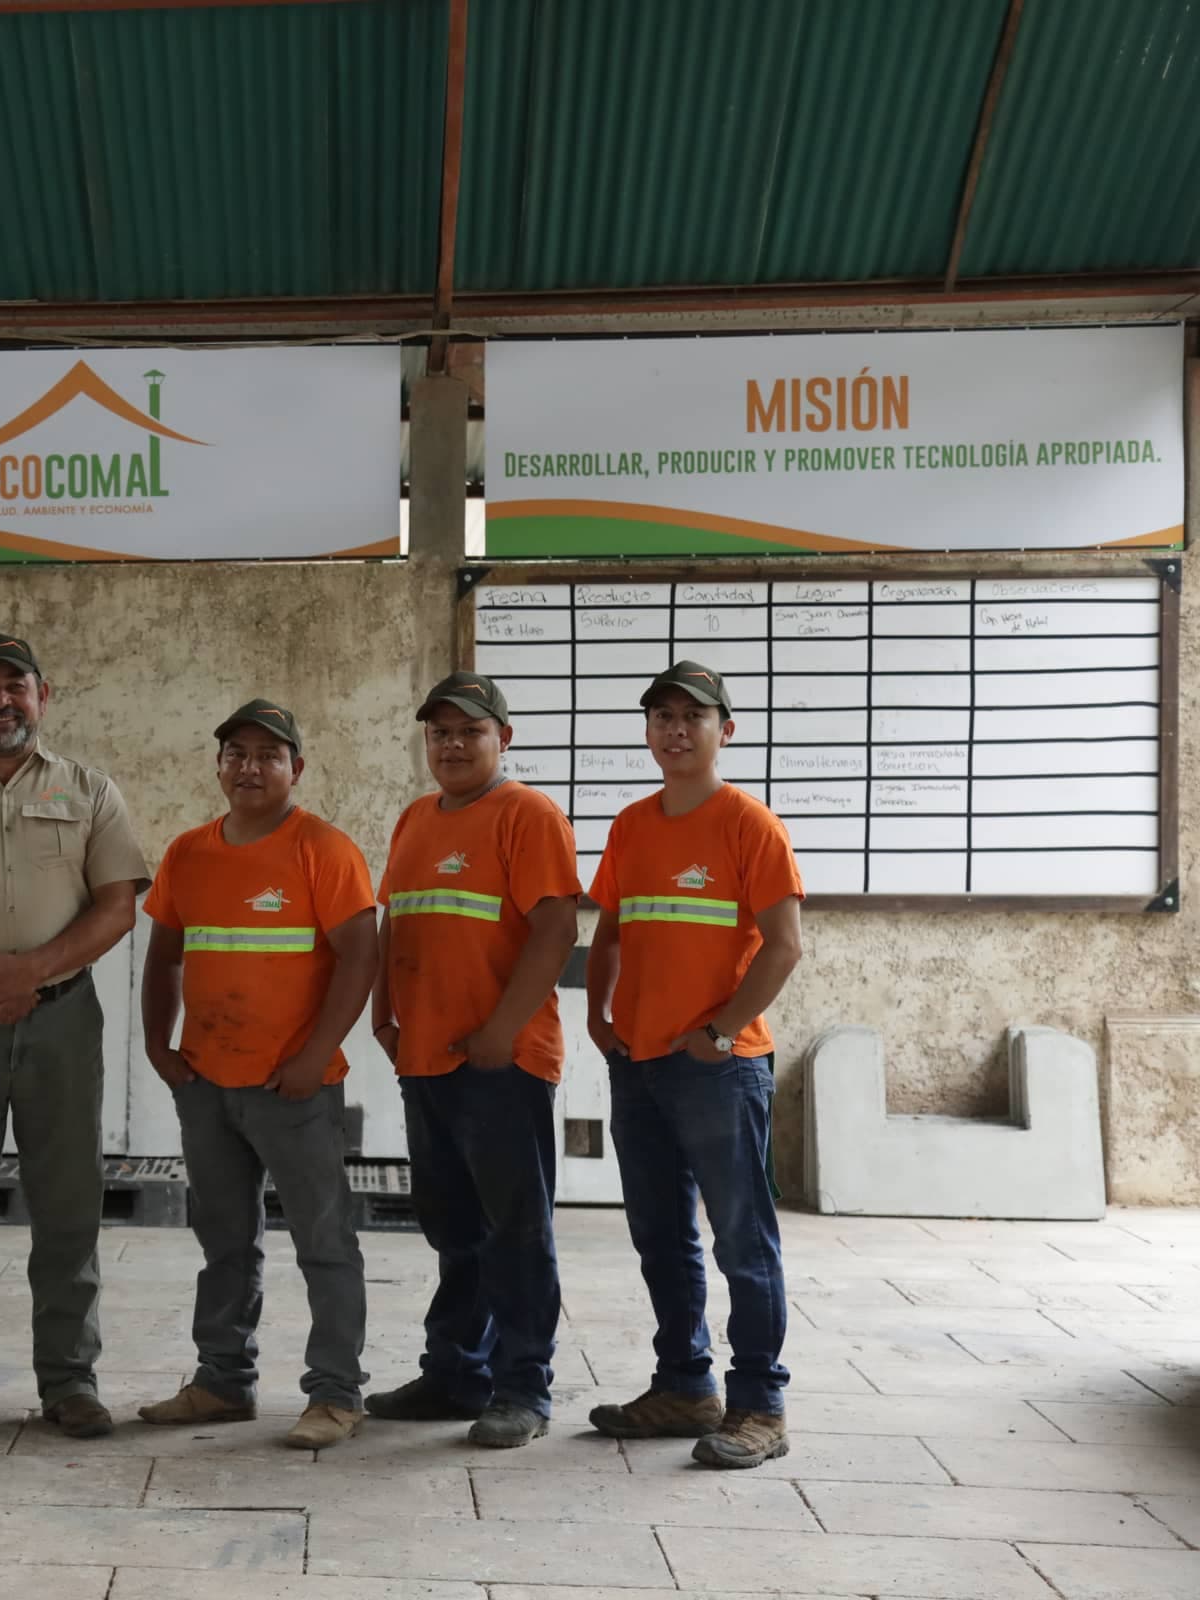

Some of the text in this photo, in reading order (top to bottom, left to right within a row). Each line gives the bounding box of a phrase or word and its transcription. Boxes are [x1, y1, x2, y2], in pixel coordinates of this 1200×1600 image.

[746, 367, 910, 433] MISIÓN
[658, 449, 757, 474] PRODUCIR
[764, 449, 777, 472] Y
[784, 447, 897, 472] PROMOVER
[903, 439, 1029, 469] TECNOLOGÍA
[1035, 439, 1162, 466] APROPIADA.
[23, 503, 77, 516] AMBIENTE
[80, 503, 88, 515] Y
[90, 501, 154, 515] ECONOMÍA
[682, 585, 755, 604] Cantidad
[795, 585, 843, 602] Lugar
